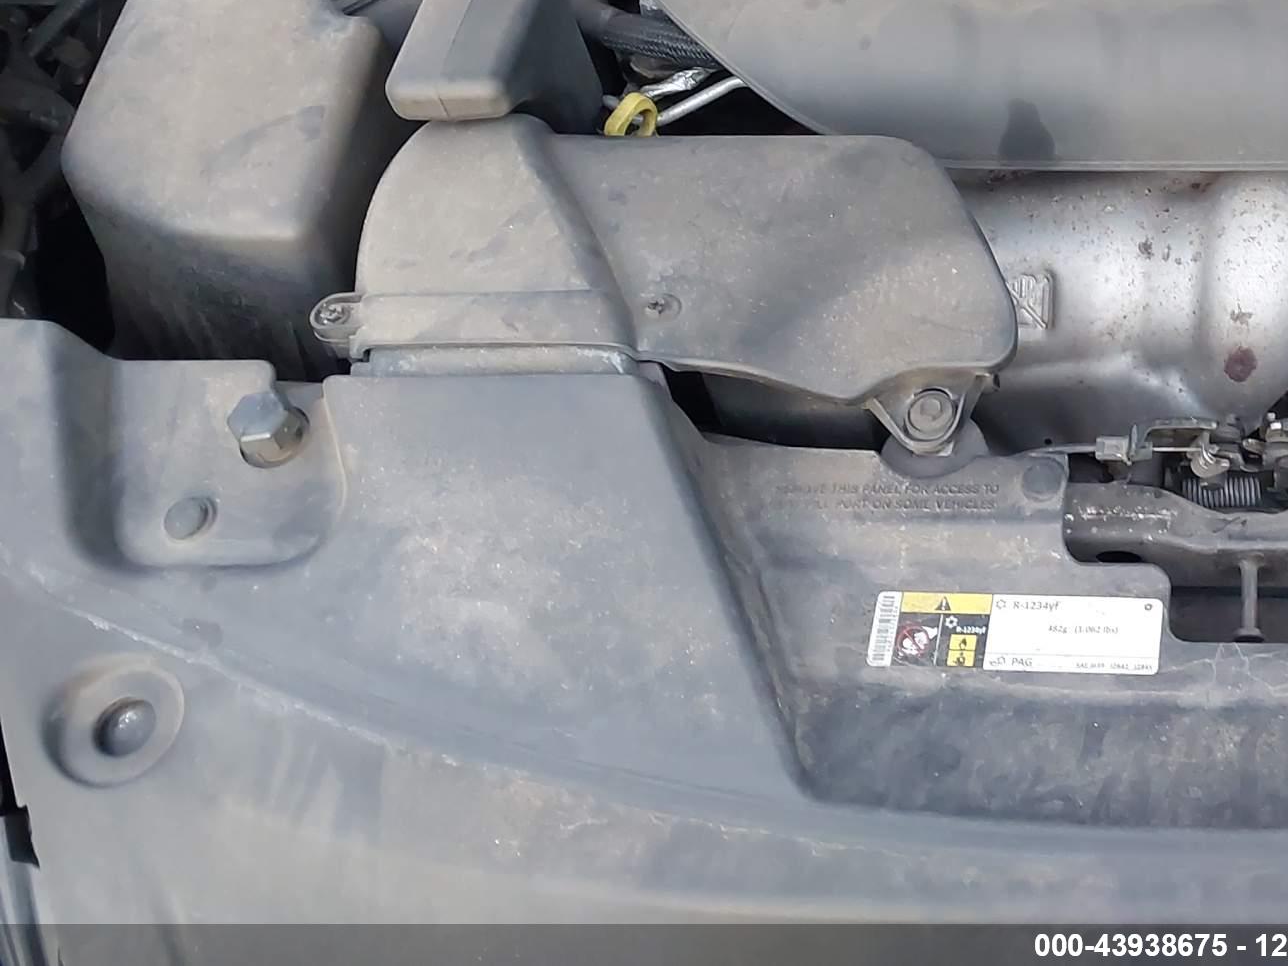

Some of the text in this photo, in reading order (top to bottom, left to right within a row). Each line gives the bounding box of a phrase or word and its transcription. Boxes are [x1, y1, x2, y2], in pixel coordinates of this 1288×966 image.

[934, 484, 979, 496] ACCESS
[982, 484, 999, 495] TO
[1011, 657, 1033, 667] PAG
